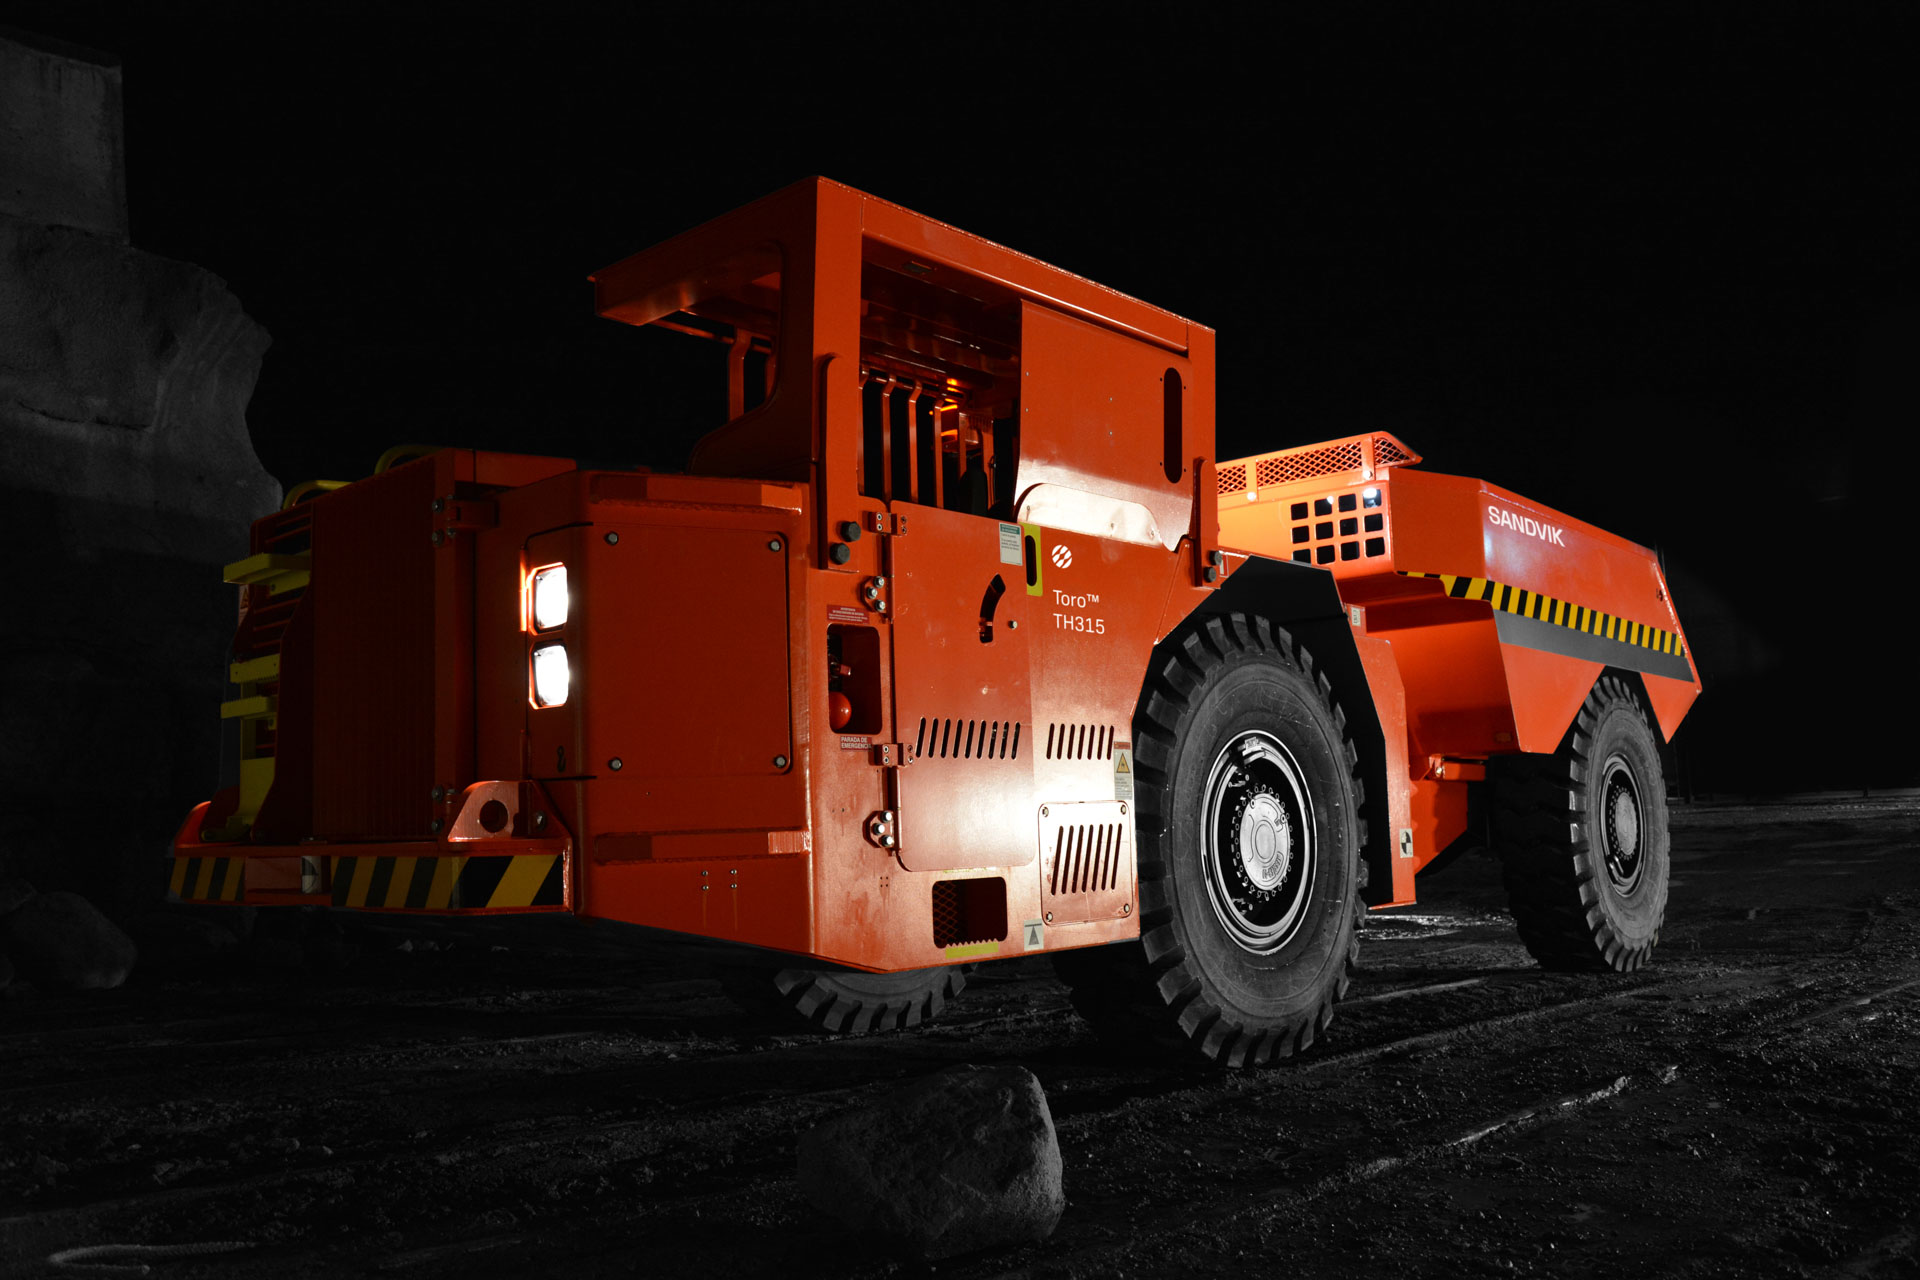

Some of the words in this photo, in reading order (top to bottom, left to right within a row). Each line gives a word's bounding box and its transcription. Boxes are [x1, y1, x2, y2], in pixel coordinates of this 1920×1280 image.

[1488, 505, 1566, 548] SANDVIK
[1052, 589, 1100, 608] Toro™
[1052, 613, 1105, 635] TH315
